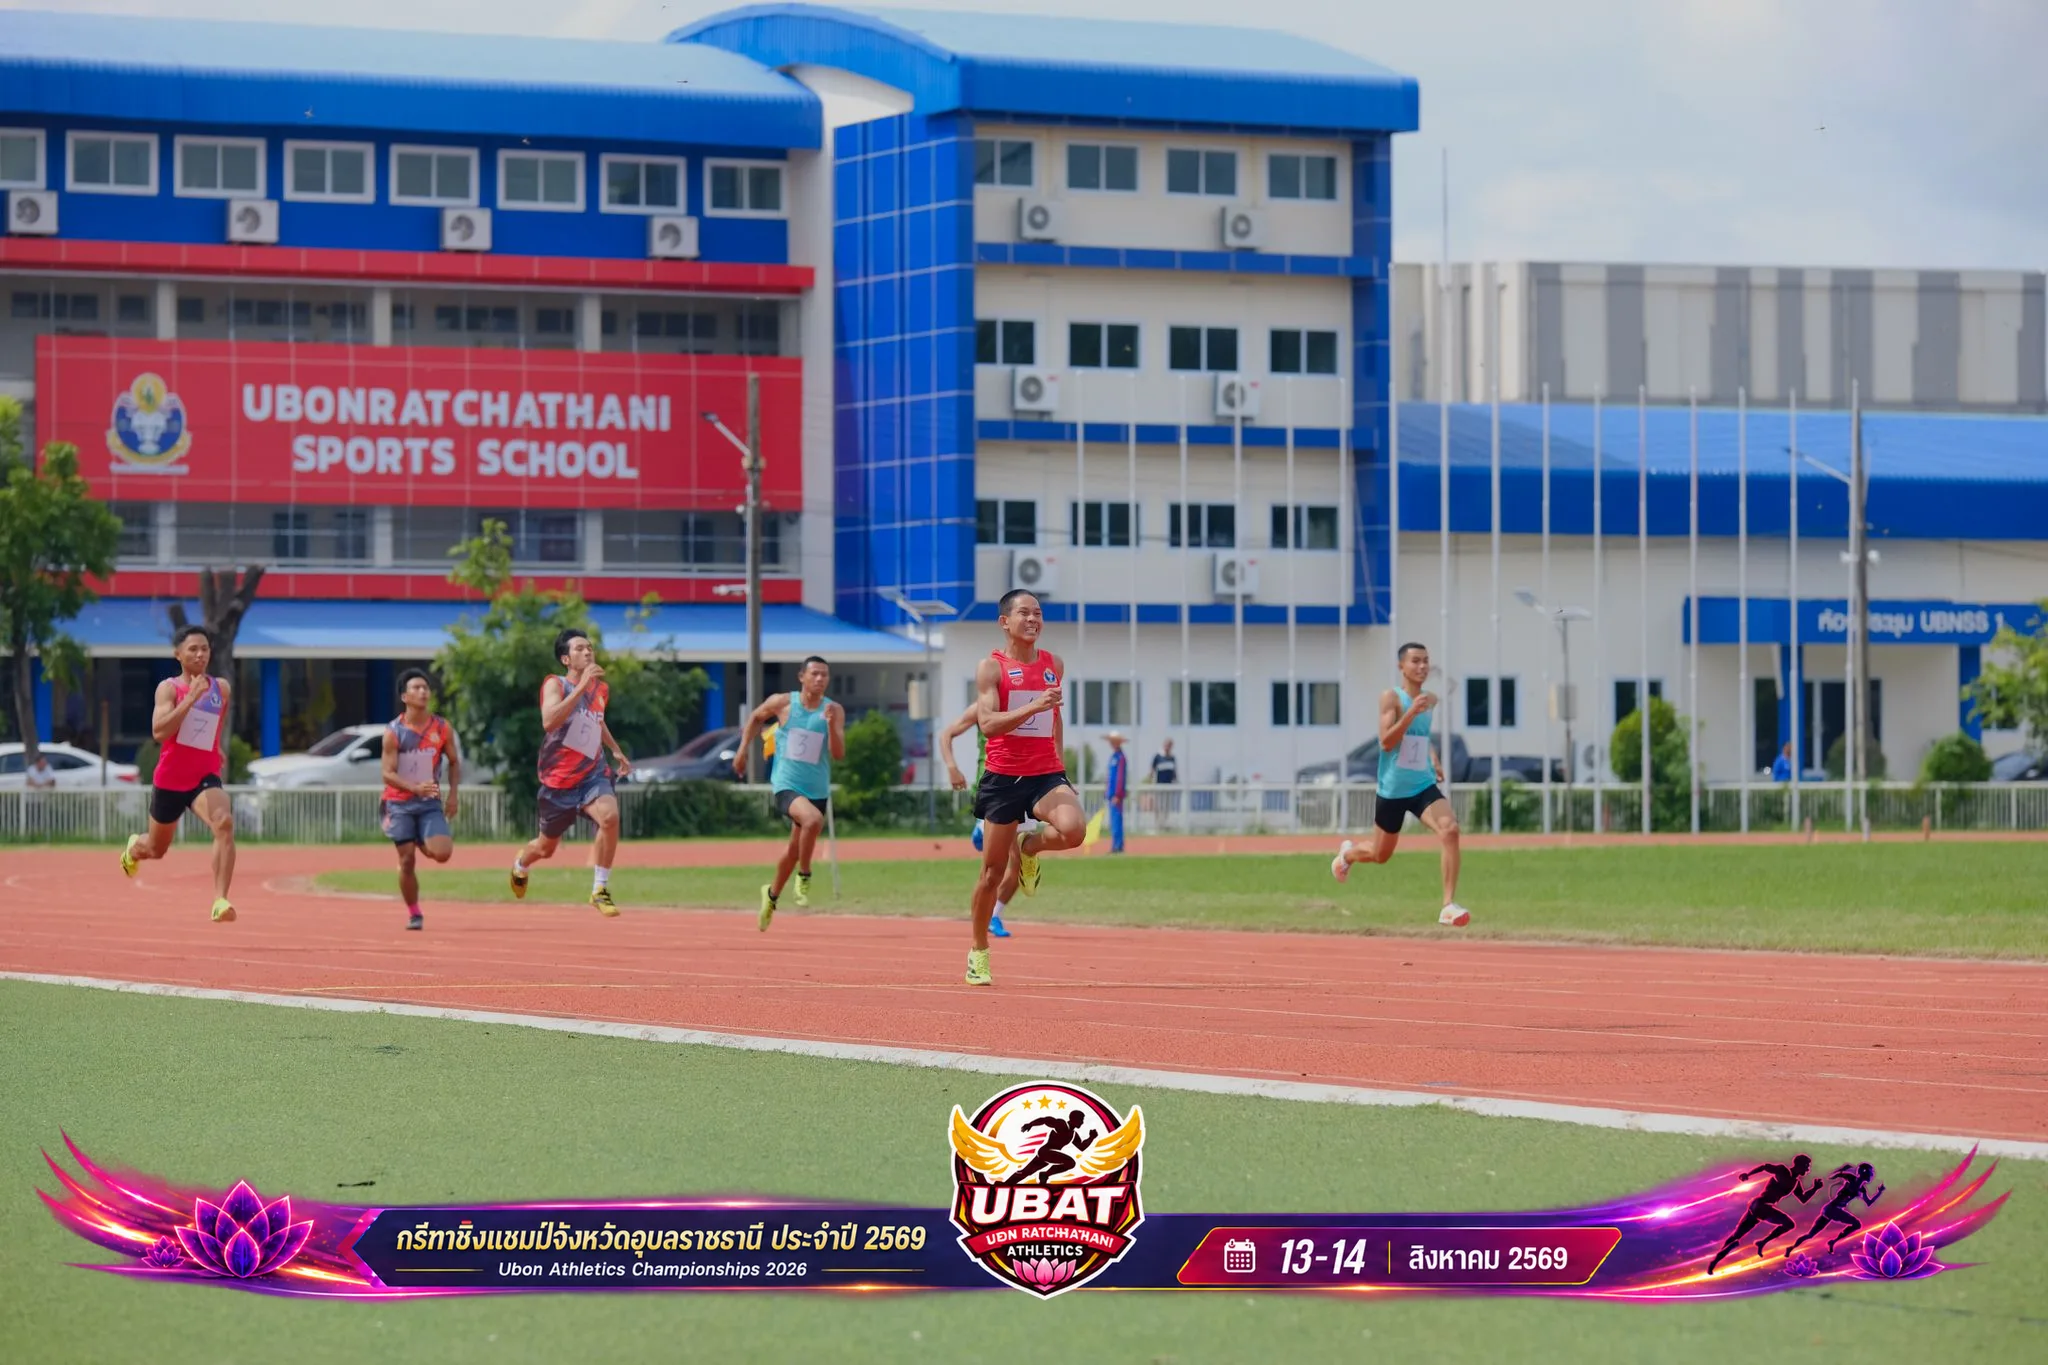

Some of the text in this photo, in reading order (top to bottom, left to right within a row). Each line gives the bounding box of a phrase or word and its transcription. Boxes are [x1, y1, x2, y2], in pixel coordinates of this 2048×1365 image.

[242, 384, 672, 432] UBONRATCHATHANI
[292, 434, 639, 479] SPORTS SCHOOL
[191, 717, 208, 742] 7
[793, 734, 808, 757] 3
[1408, 741, 1420, 763] 1
